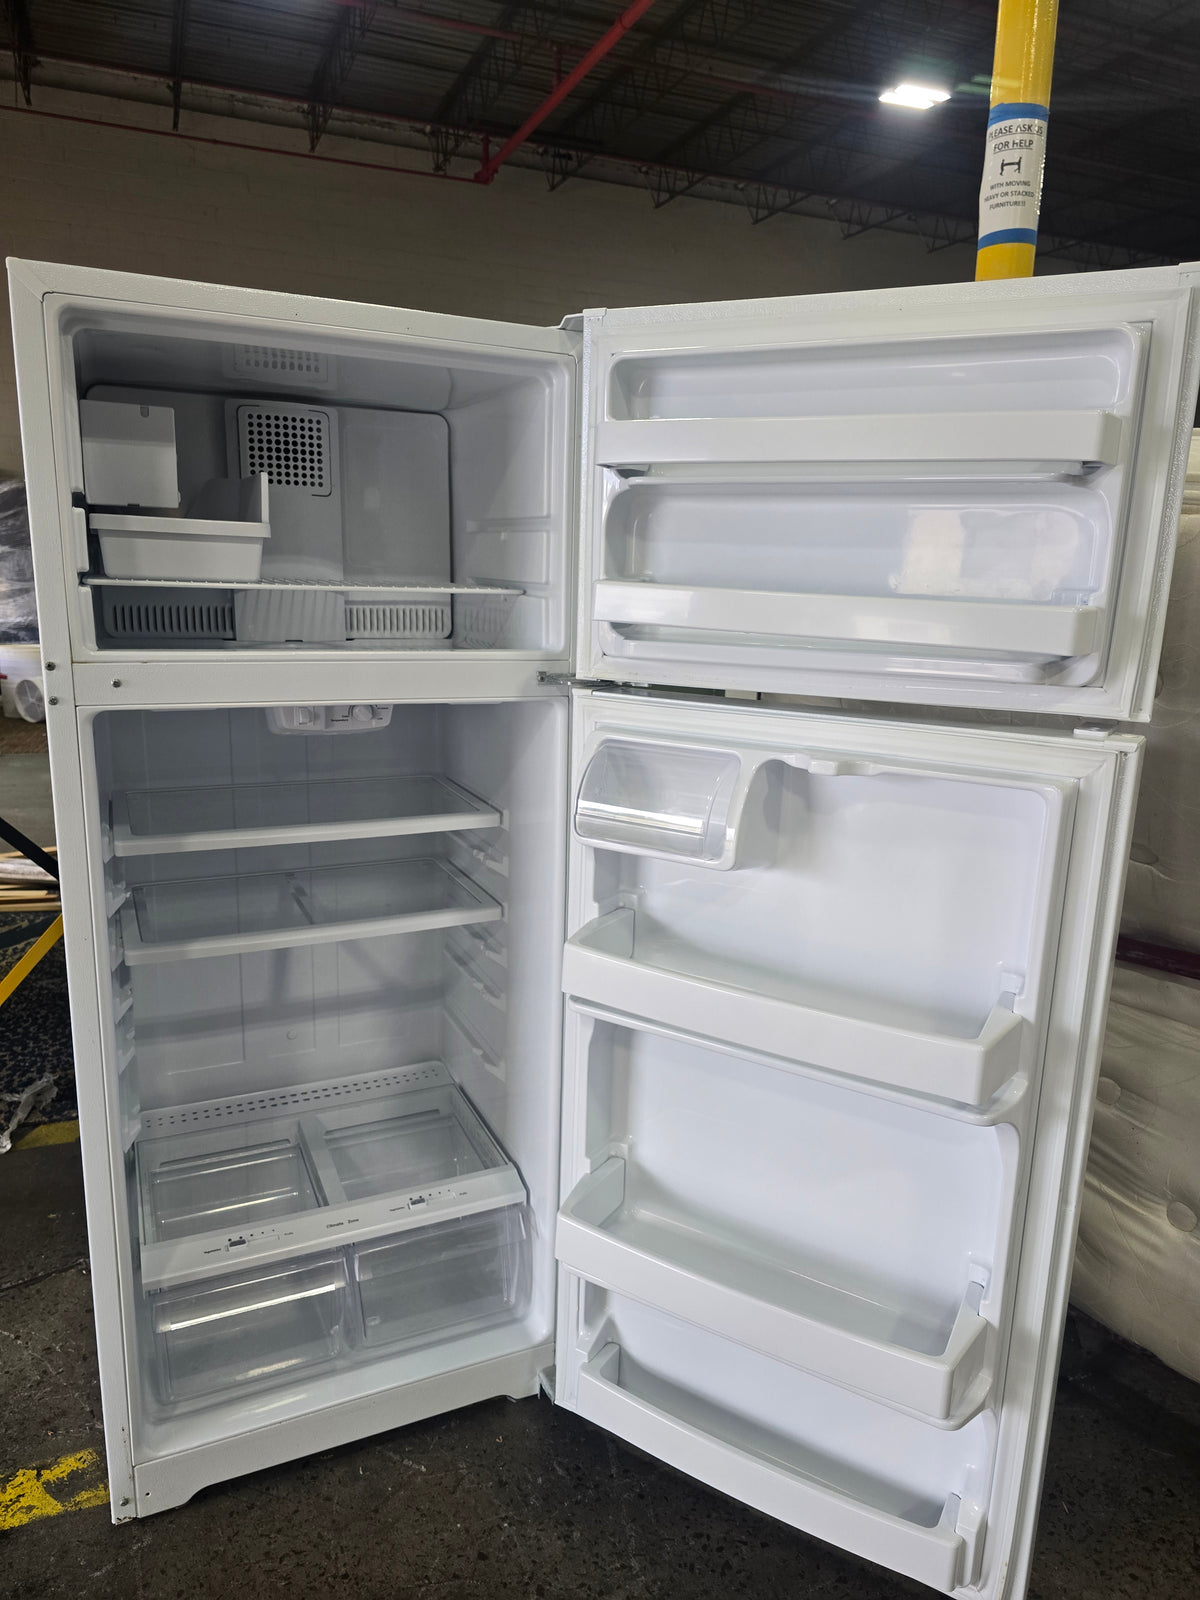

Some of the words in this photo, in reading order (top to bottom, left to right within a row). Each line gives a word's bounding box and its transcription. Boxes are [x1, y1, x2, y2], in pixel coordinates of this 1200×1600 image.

[1015, 124, 1033, 132] ASK
[993, 140, 1010, 152] FOR
[1011, 139, 1034, 148] HELP
[990, 182, 1004, 190] WITH
[1010, 190, 1035, 198] STACKED
